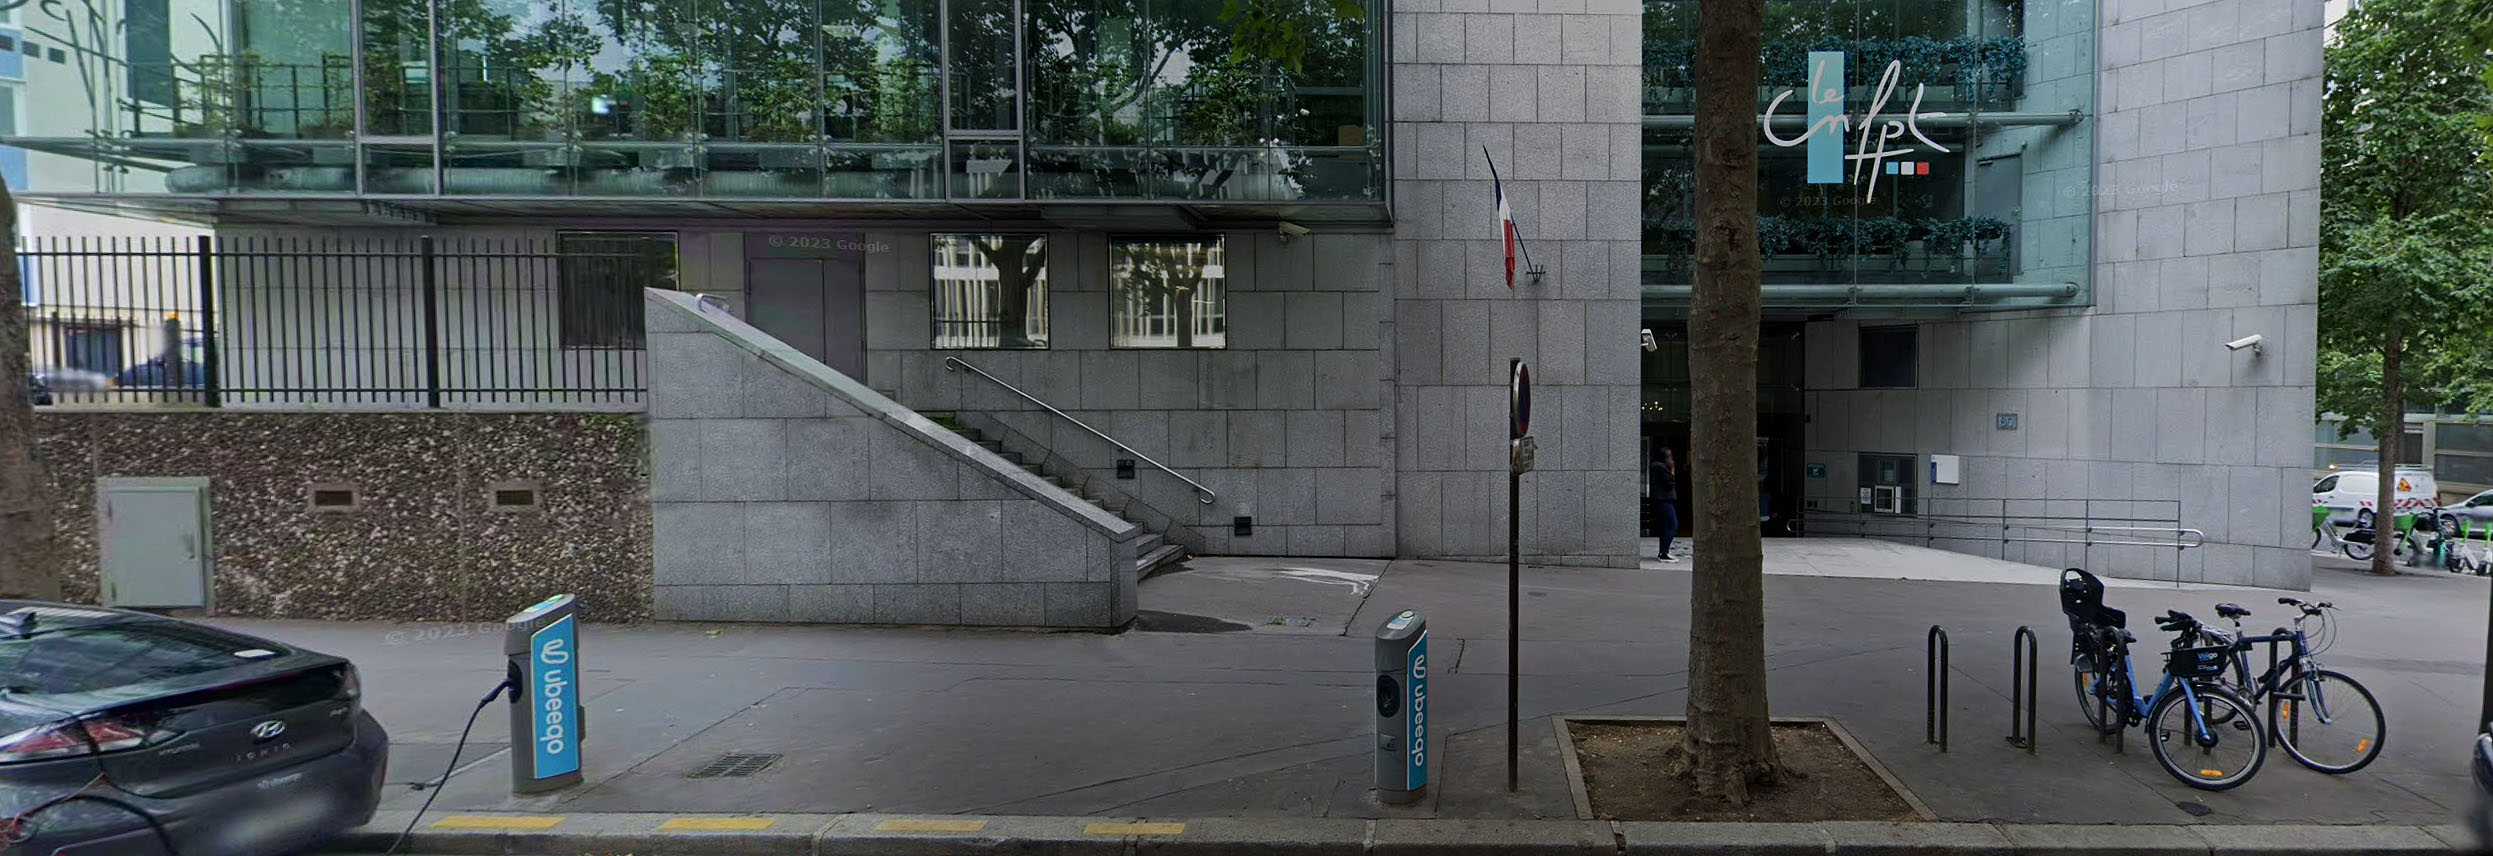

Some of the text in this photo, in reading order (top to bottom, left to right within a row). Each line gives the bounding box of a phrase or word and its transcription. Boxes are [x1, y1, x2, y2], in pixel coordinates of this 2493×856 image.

[1812, 59, 1845, 104] le
[539, 669, 568, 755] ubeeqo
[1411, 683, 1427, 767] ubeeqo
